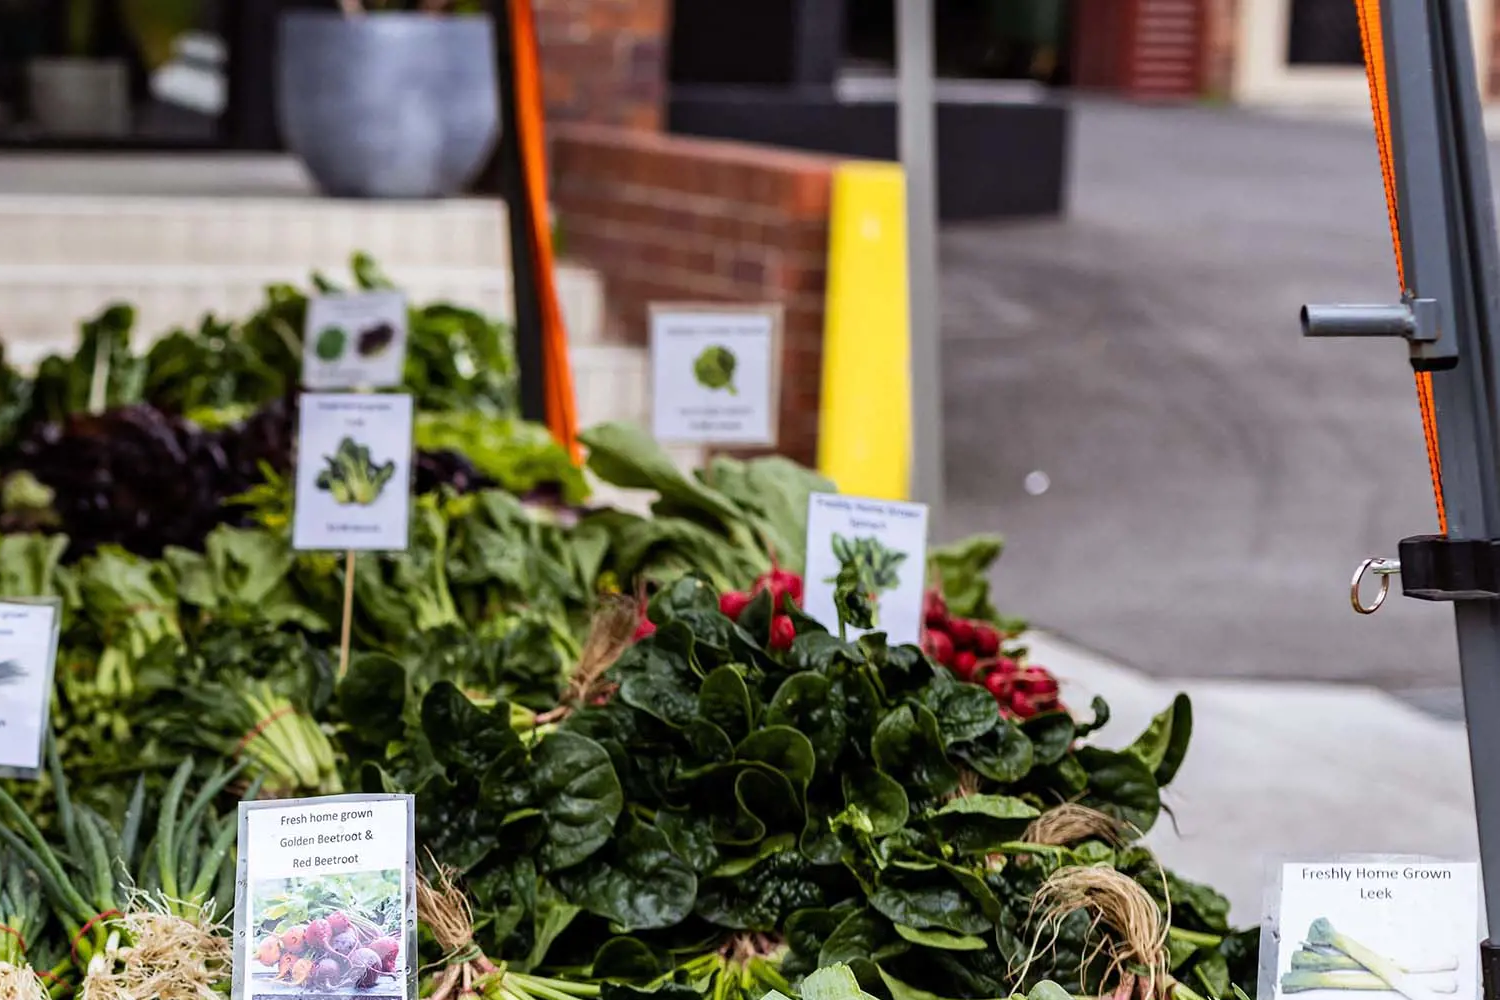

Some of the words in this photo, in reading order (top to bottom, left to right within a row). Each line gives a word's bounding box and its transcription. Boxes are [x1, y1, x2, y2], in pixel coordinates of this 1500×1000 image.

[280, 814, 307, 826] Fresh
[310, 811, 338, 823] home
[341, 809, 373, 821] grown
[280, 836, 315, 848] Golden
[317, 832, 362, 844] Beetroot
[365, 830, 374, 840] &
[293, 857, 312, 868] Red
[314, 854, 359, 866] Beetroot
[1302, 867, 1351, 882] Freshly
[1356, 868, 1399, 880] Home
[1403, 867, 1452, 880] Grown
[1360, 887, 1393, 899] Leek
